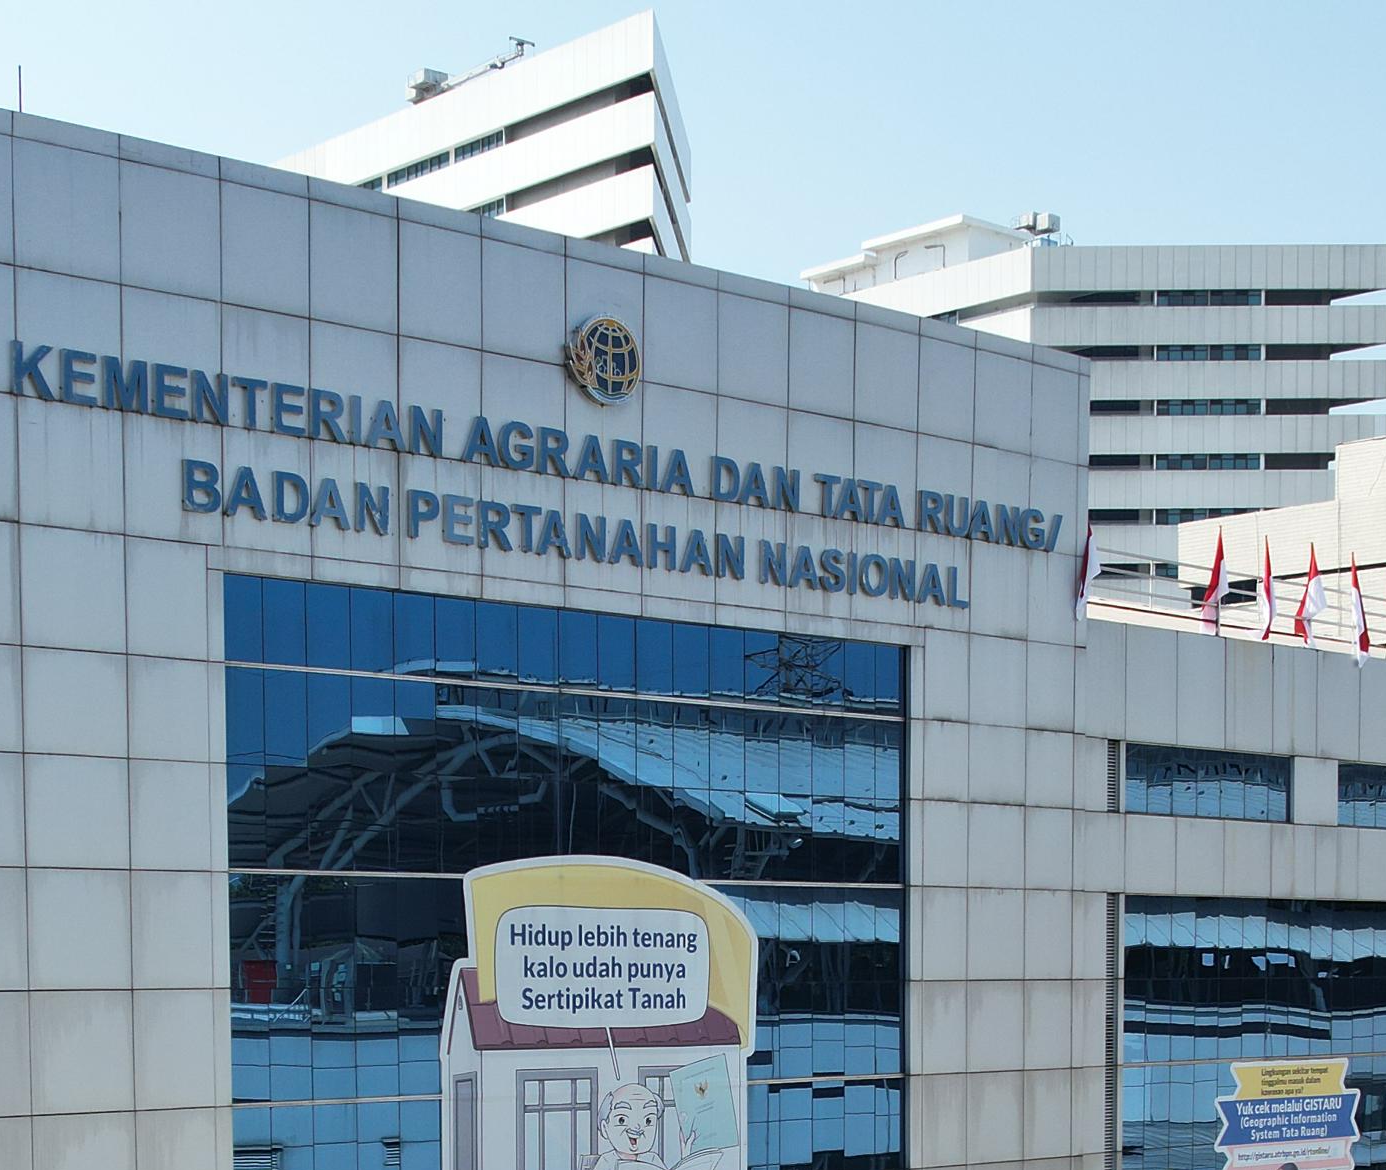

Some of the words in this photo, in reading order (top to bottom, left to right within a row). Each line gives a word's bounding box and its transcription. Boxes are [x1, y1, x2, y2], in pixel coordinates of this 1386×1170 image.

[11, 340, 443, 457] KEMENTERIAN
[463, 416, 694, 497] AGRARIA
[711, 455, 801, 513] DAN
[814, 472, 906, 528] TATA
[918, 489, 1063, 552] RUANG/
[182, 458, 390, 536] BADAN
[406, 488, 745, 581] PERTANAHAN
[759, 539, 969, 609] NASIONAL
[510, 923, 573, 951] Hidup
[577, 925, 628, 948] lebih
[631, 929, 698, 954] tenang
[523, 956, 568, 978] kalo
[572, 956, 623, 979] udah
[627, 961, 687, 983] punya
[521, 987, 624, 1014] Sertipikat
[628, 987, 687, 1010] Tanah
[1236, 1101, 1254, 1116] Yuk
[1254, 1101, 1270, 1115] cek
[1271, 1099, 1302, 1113] melalui
[1303, 1097, 1342, 1112] GISTARU
[1240, 1114, 1289, 1129] (Geographic
[1290, 1112, 1337, 1124] Information
[1251, 1129, 1280, 1141] System
[1281, 1127, 1299, 1138] Tata
[1300, 1124, 1328, 1138] Ruang)
